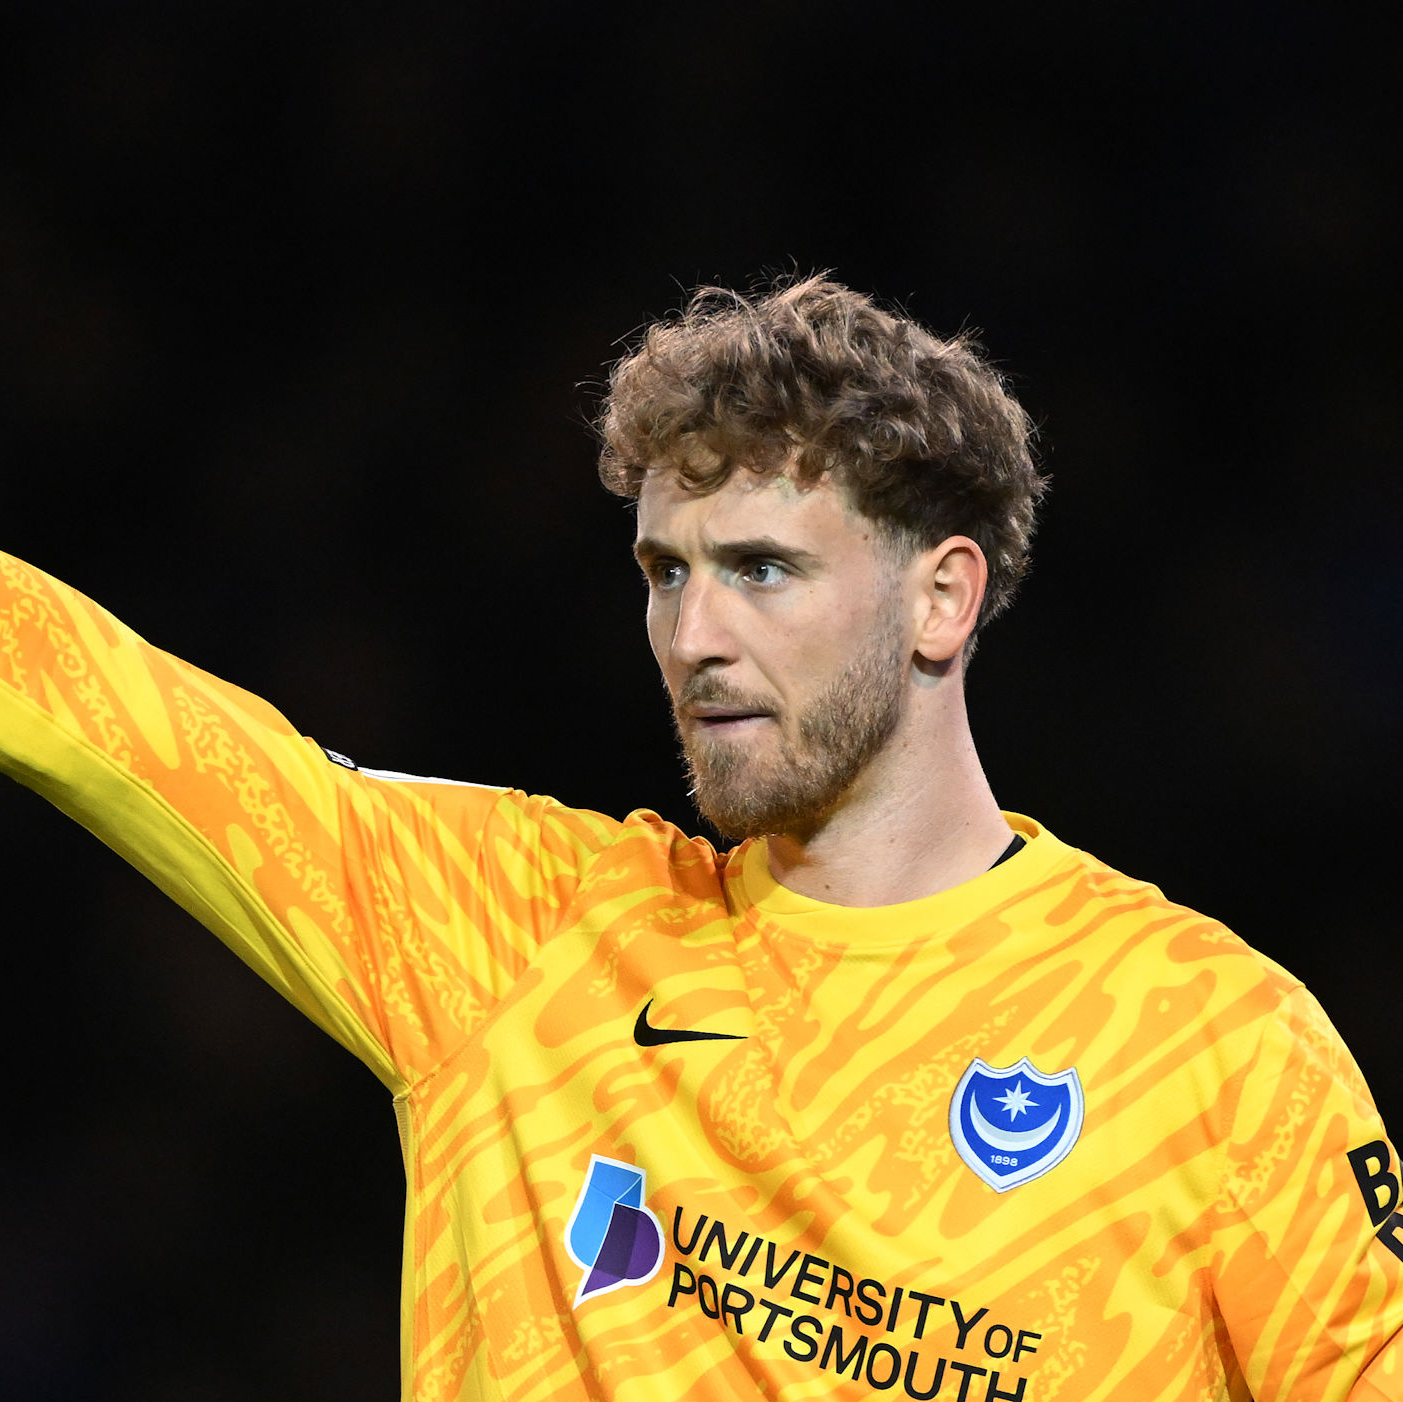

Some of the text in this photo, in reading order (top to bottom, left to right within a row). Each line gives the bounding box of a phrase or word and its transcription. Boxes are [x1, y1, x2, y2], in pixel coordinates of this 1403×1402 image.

[990, 1154, 1018, 1166] 1898
[672, 1206, 1042, 1362] UNIVERSITY OF
